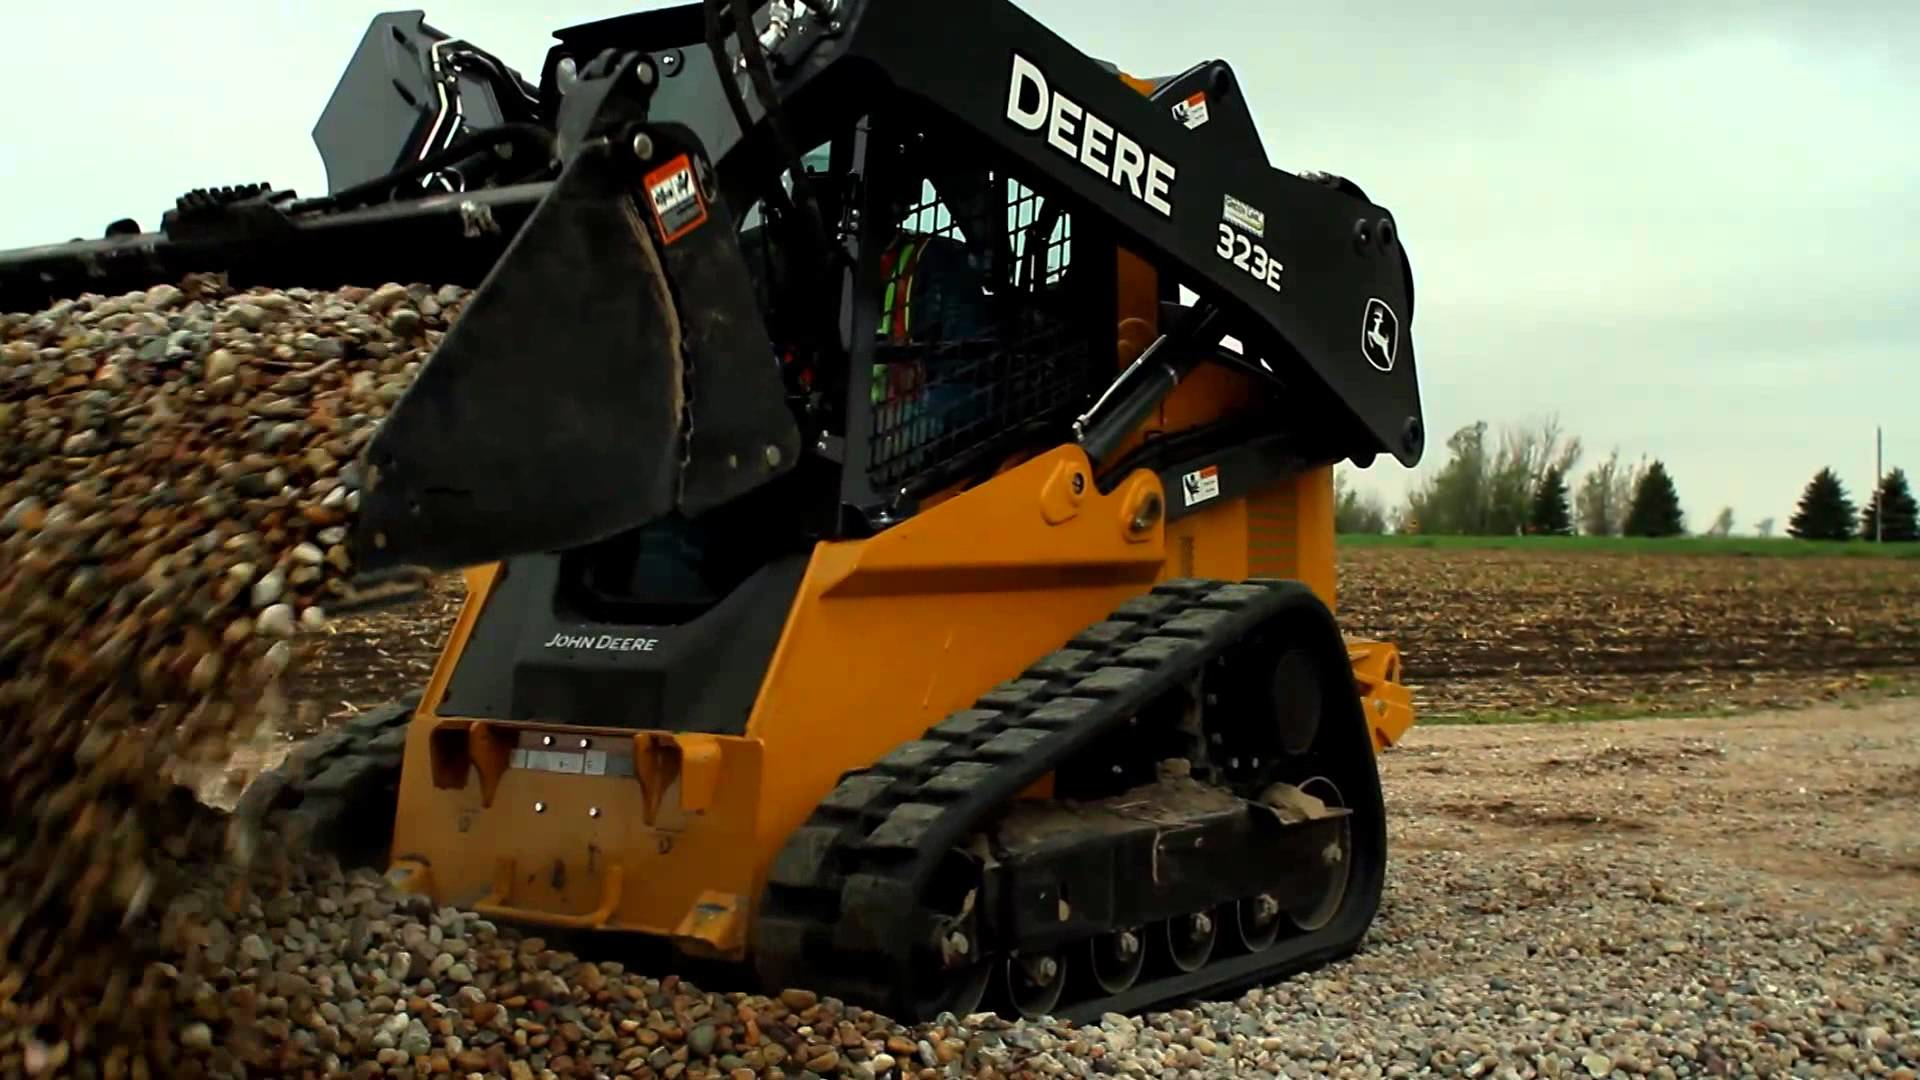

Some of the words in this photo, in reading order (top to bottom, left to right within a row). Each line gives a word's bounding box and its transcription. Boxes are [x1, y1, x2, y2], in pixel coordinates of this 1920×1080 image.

[1007, 53, 1175, 216] DEERE
[1217, 223, 1283, 292] 323E
[544, 633, 595, 649] JOHN
[595, 635, 659, 651] DEERE
